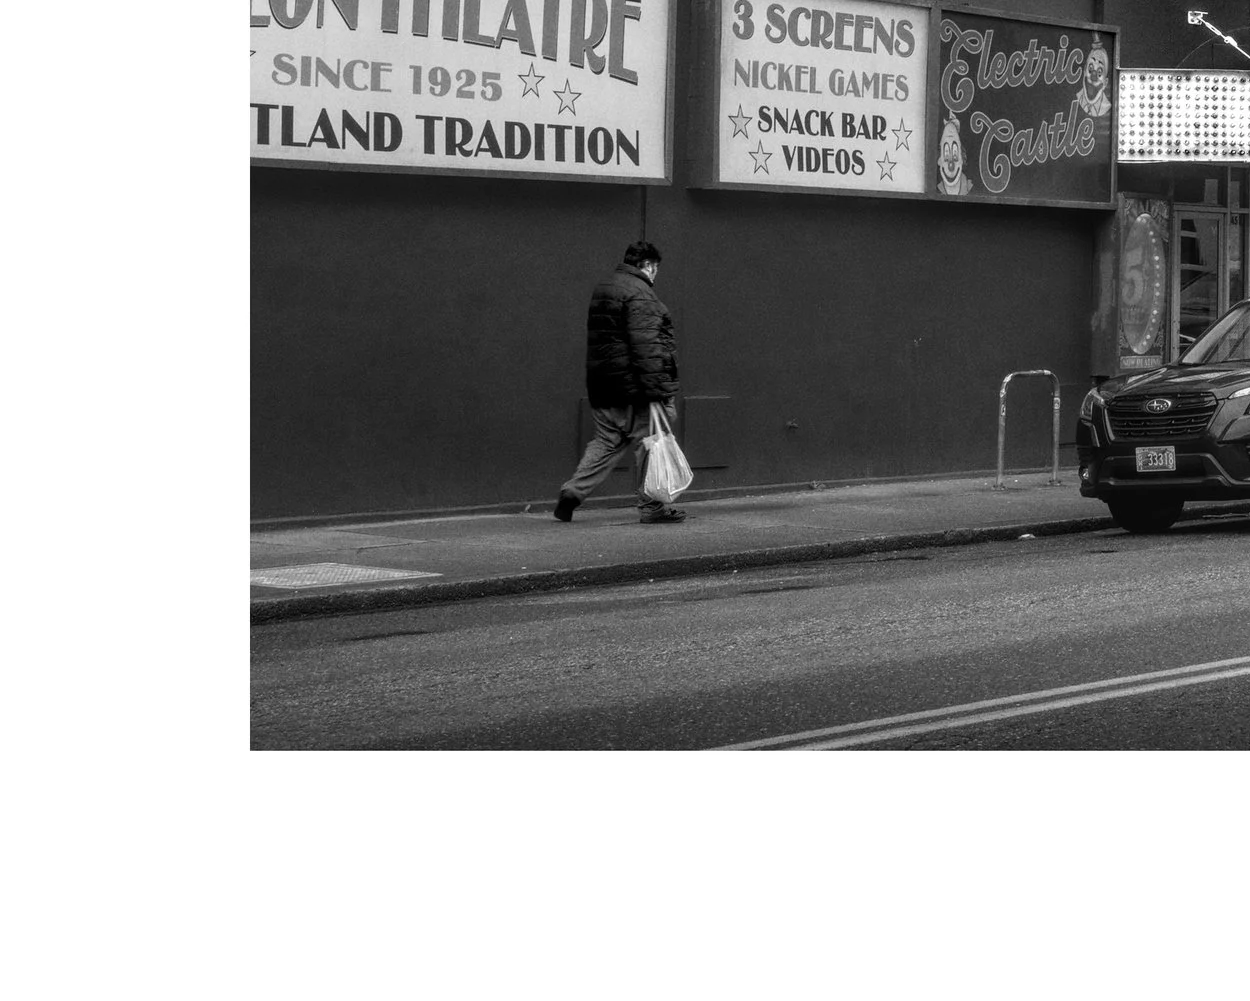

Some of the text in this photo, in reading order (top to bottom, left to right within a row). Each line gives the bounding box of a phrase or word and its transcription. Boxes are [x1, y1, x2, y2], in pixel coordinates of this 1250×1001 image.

[732, 0, 916, 58] 3 SCREENS
[271, 53, 503, 102] SINCE 1925
[734, 58, 910, 102] NICKEL GAMES
[940, 18, 1084, 113] Electric
[250, 103, 640, 166] TLAND TRADITION
[757, 106, 887, 141] SNACK BAR
[970, 99, 1096, 193] Castle
[782, 145, 866, 176] VIDEOS
